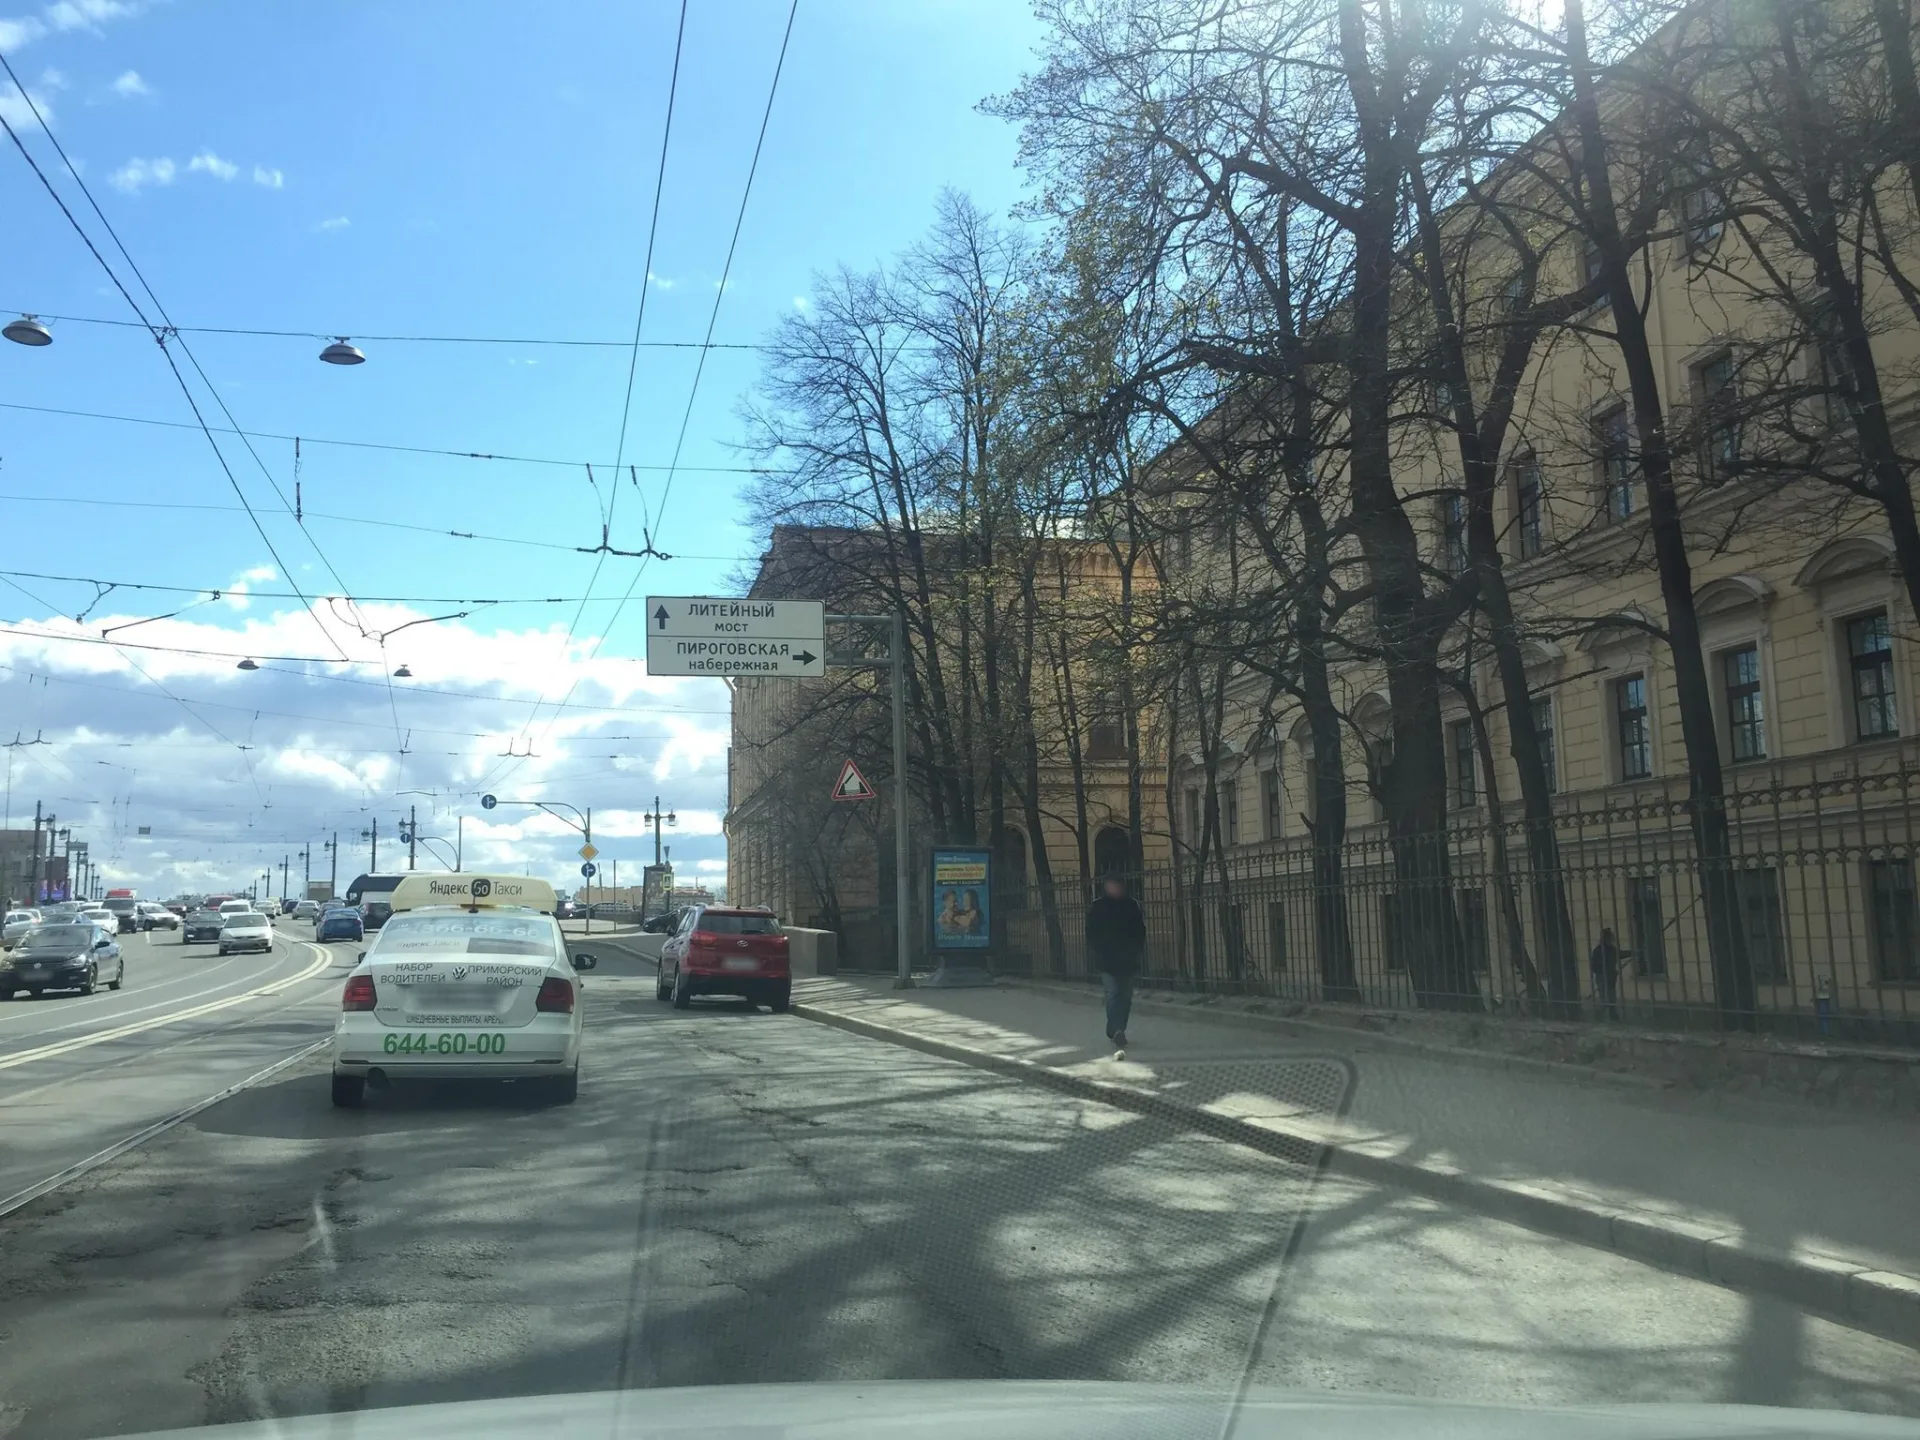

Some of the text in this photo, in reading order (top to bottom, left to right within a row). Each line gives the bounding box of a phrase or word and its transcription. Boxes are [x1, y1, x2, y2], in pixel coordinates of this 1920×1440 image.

[688, 602, 775, 617] ЛИТЕЙНЫЙ
[714, 622, 749, 632] мост
[677, 642, 789, 656] ПИРОГОВСКАЯ
[689, 658, 778, 672] набережная
[429, 880, 468, 895] Яндекс
[493, 881, 522, 895] Такси
[396, 963, 433, 972] НАБОР
[468, 965, 543, 977] ПРИМОРСКИЙ
[381, 973, 447, 984] ВОДИТЕЛЕЙ
[486, 976, 523, 986] РАЙОН
[383, 1033, 506, 1055] 644-60-00
